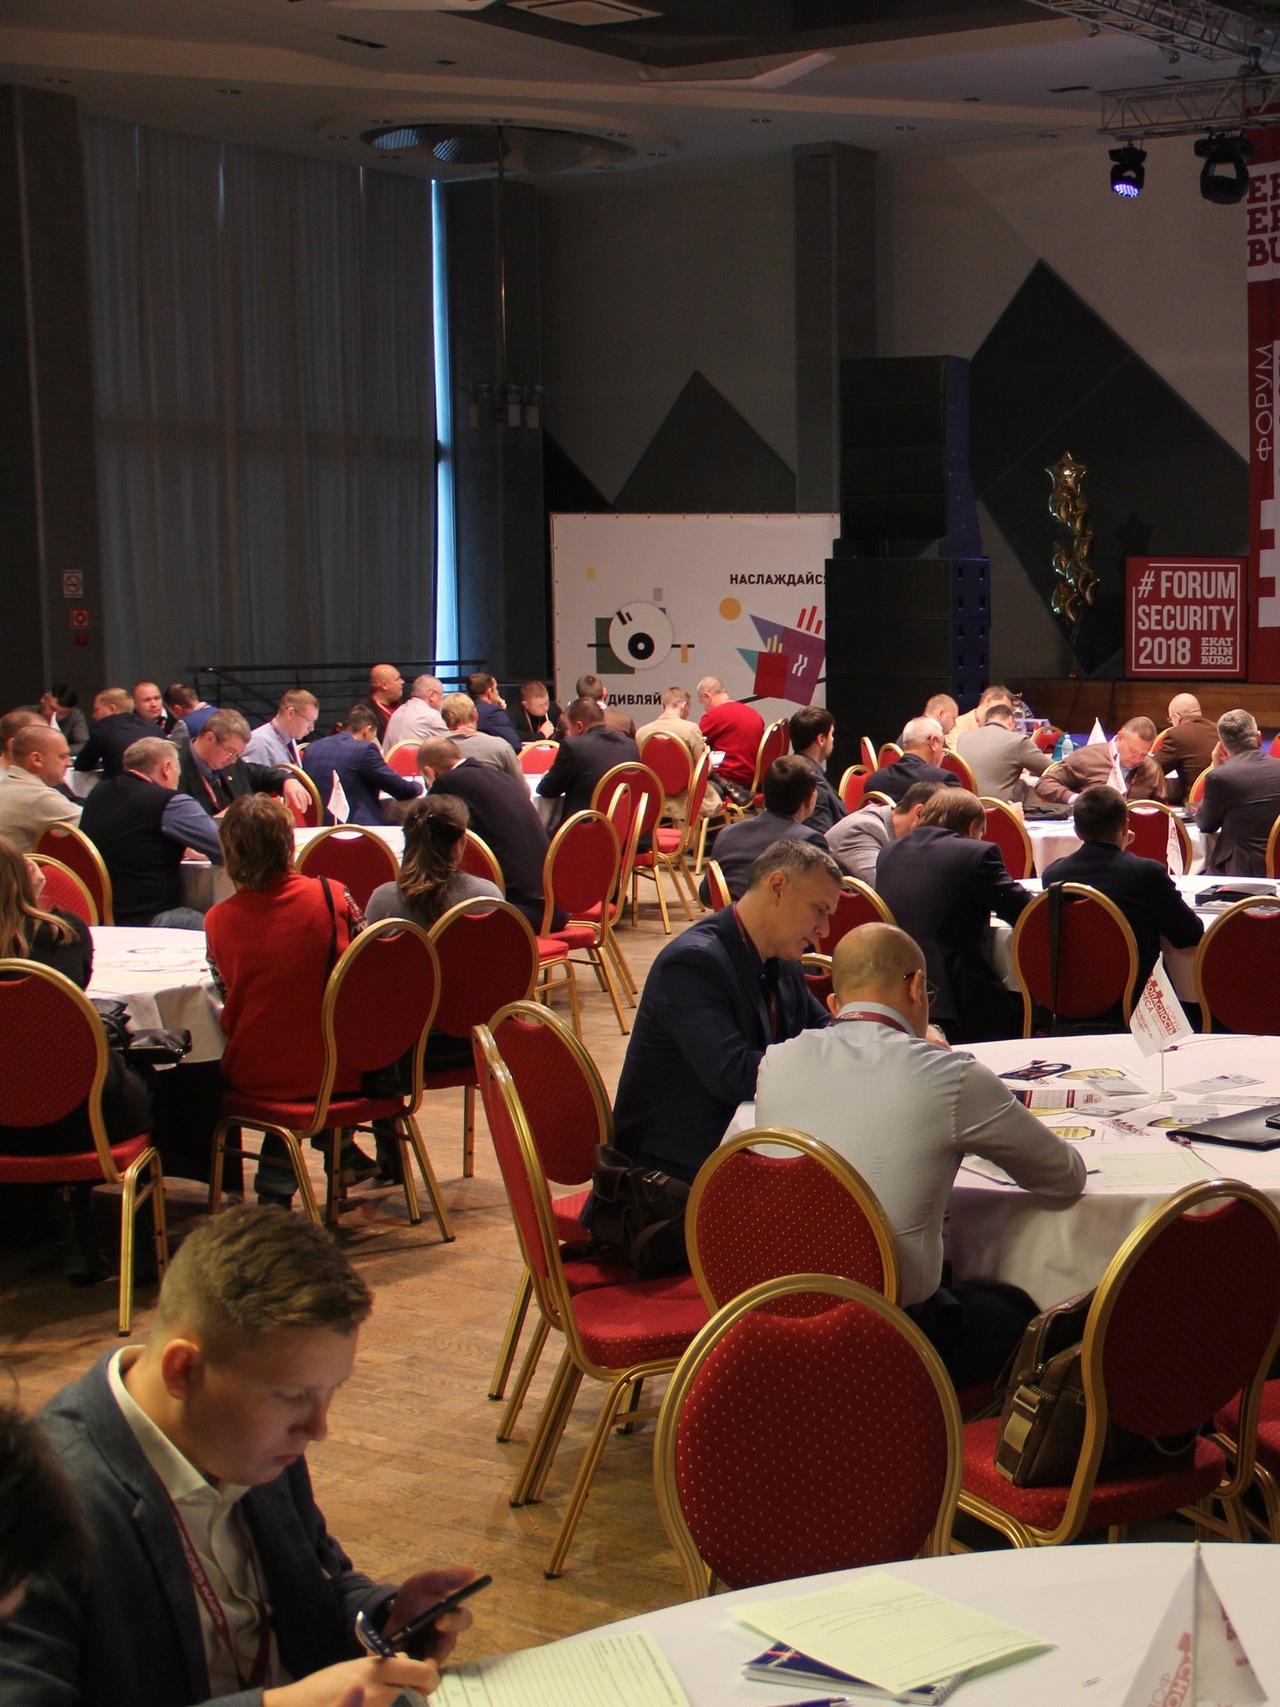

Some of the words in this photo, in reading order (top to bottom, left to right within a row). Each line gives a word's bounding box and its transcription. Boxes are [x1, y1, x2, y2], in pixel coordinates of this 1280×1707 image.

[1255, 344, 1272, 461] ФОРУМ
[1137, 605, 1235, 631] SECURITY
[1201, 637, 1233, 646] EKAT
[1138, 637, 1191, 665] 2018
[1201, 646, 1233, 655] ERIN
[1201, 656, 1233, 665] BURG
